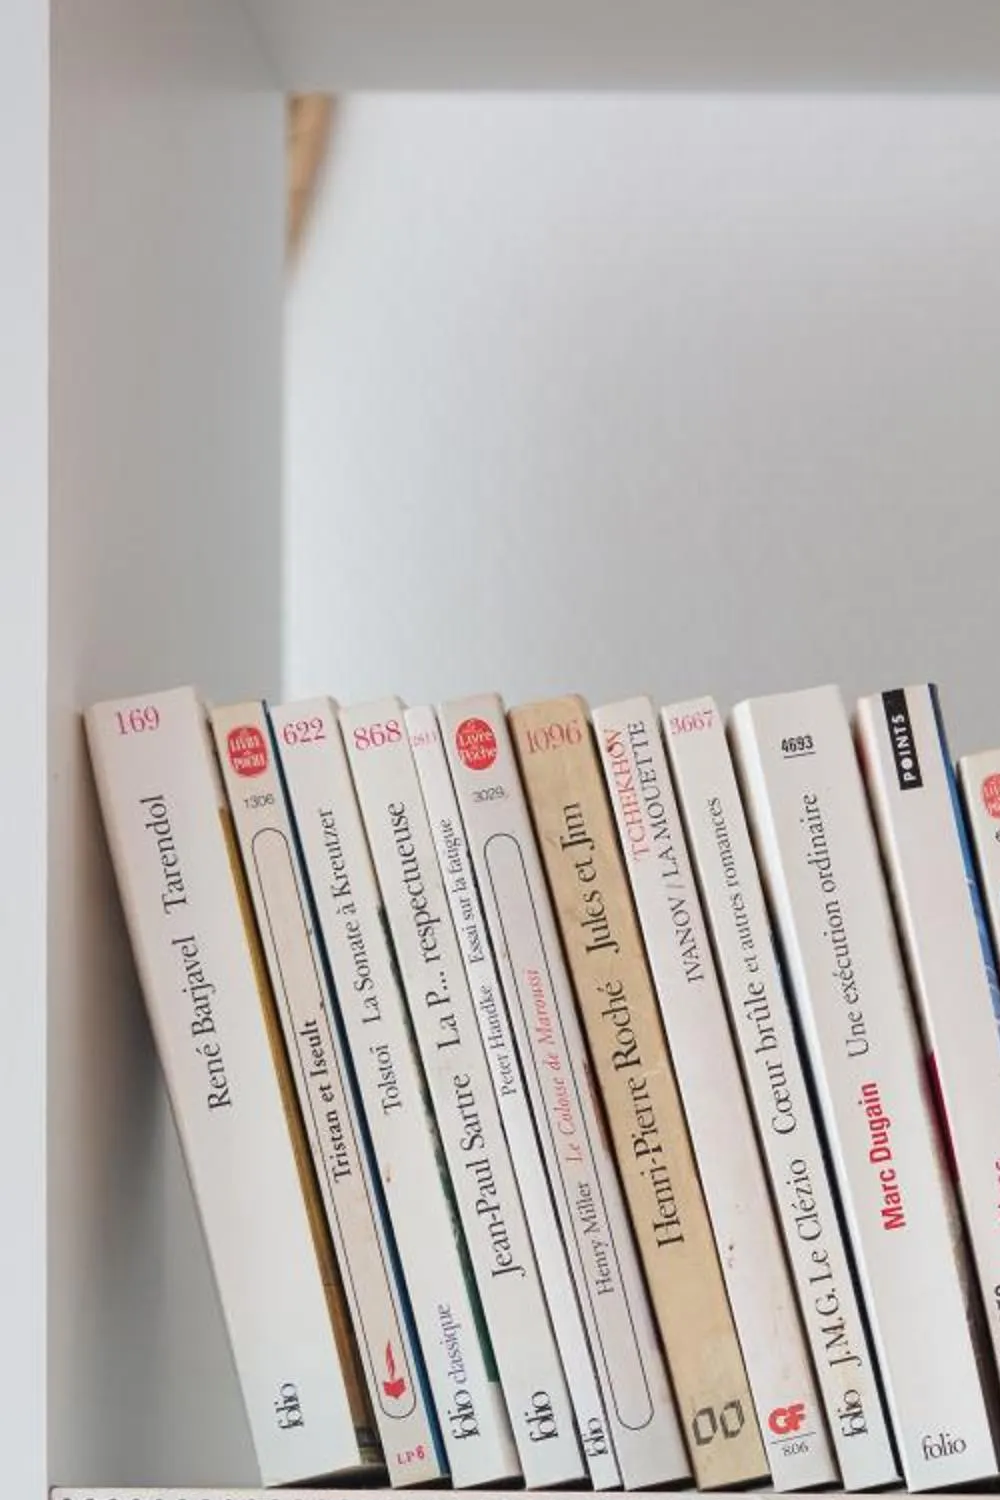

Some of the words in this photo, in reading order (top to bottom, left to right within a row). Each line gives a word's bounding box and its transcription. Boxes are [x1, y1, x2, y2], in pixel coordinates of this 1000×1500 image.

[115, 705, 160, 735] 169
[283, 718, 325, 745] 622
[353, 718, 402, 750] 868
[890, 714, 917, 782] POINTS
[604, 727, 650, 862] TCHEKHOV
[628, 721, 672, 842] MOUETTE
[140, 794, 187, 915] Tarendol
[320, 808, 352, 899] Kreutzer
[441, 818, 463, 875] fatigue
[560, 802, 596, 852] Jim
[708, 796, 739, 888] romances
[800, 793, 837, 894] ordinaire
[387, 801, 441, 963] respectueuse
[451, 876, 467, 893] la
[575, 857, 597, 884] et
[658, 844, 680, 880] LA
[336, 901, 358, 915] à
[459, 898, 475, 921] sur
[581, 889, 620, 955] Jules
[669, 896, 704, 982] IVANOV
[731, 892, 755, 951] autres
[345, 920, 375, 992] Sonate
[464, 926, 484, 963] Essai
[744, 953, 760, 973] et
[824, 900, 859, 1005] exécution
[171, 935, 217, 1039] Barjavel
[362, 995, 381, 1023] La
[479, 984, 505, 1050] Handke
[525, 969, 556, 1045] Maroussi
[744, 981, 777, 1054] brûle
[300, 1019, 328, 1077] Iseult
[437, 1013, 460, 1051] La
[596, 979, 642, 1072] Roché
[846, 1010, 869, 1058] Une
[196, 1041, 232, 1110] René
[318, 1084, 334, 1102] et
[497, 1053, 517, 1097] Peter
[543, 1054, 561, 1071] de
[453, 1072, 485, 1151] Sartre
[553, 1078, 576, 1135] Colosse
[766, 1060, 798, 1135] Cœur
[858, 1083, 892, 1164] Dugain
[326, 1109, 352, 1183] Tristan
[565, 1143, 583, 1162] Le
[627, 1077, 685, 1248] Henri-Pierre
[465, 1157, 527, 1278] Jean-Paul
[576, 1182, 601, 1235] Miller
[786, 1158, 823, 1241] Clézio
[880, 1168, 906, 1231] Marc
[590, 1242, 615, 1296] Henry
[809, 1249, 833, 1283] Le
[438, 1304, 467, 1385] classique
[815, 1287, 863, 1367] J.M.G.
[768, 1402, 806, 1435] GF
[922, 1433, 967, 1461] folio
